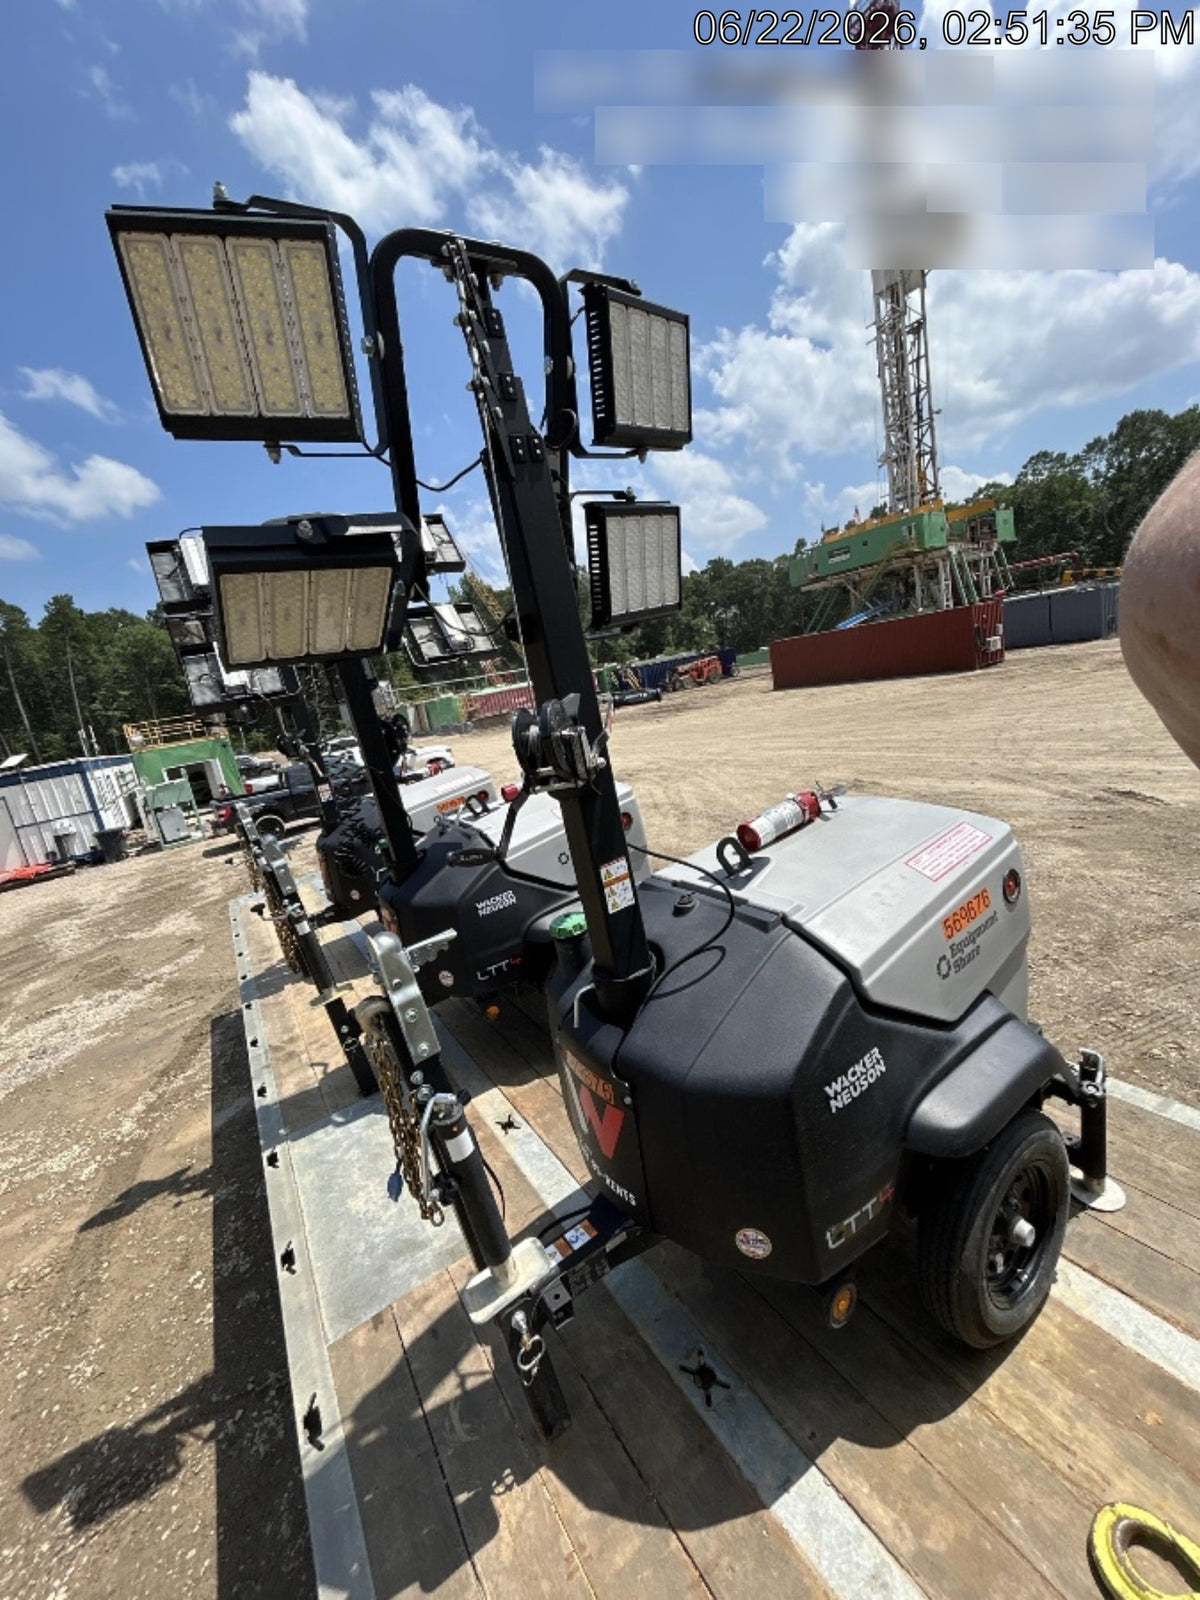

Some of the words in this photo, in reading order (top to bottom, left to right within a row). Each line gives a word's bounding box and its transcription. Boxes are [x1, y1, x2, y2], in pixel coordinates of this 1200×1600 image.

[943, 887, 990, 939] 569676
[949, 910, 998, 958] Equipment
[952, 945, 980, 974] Share
[824, 1046, 882, 1098] WACKER
[829, 1059, 887, 1113] NEUSON
